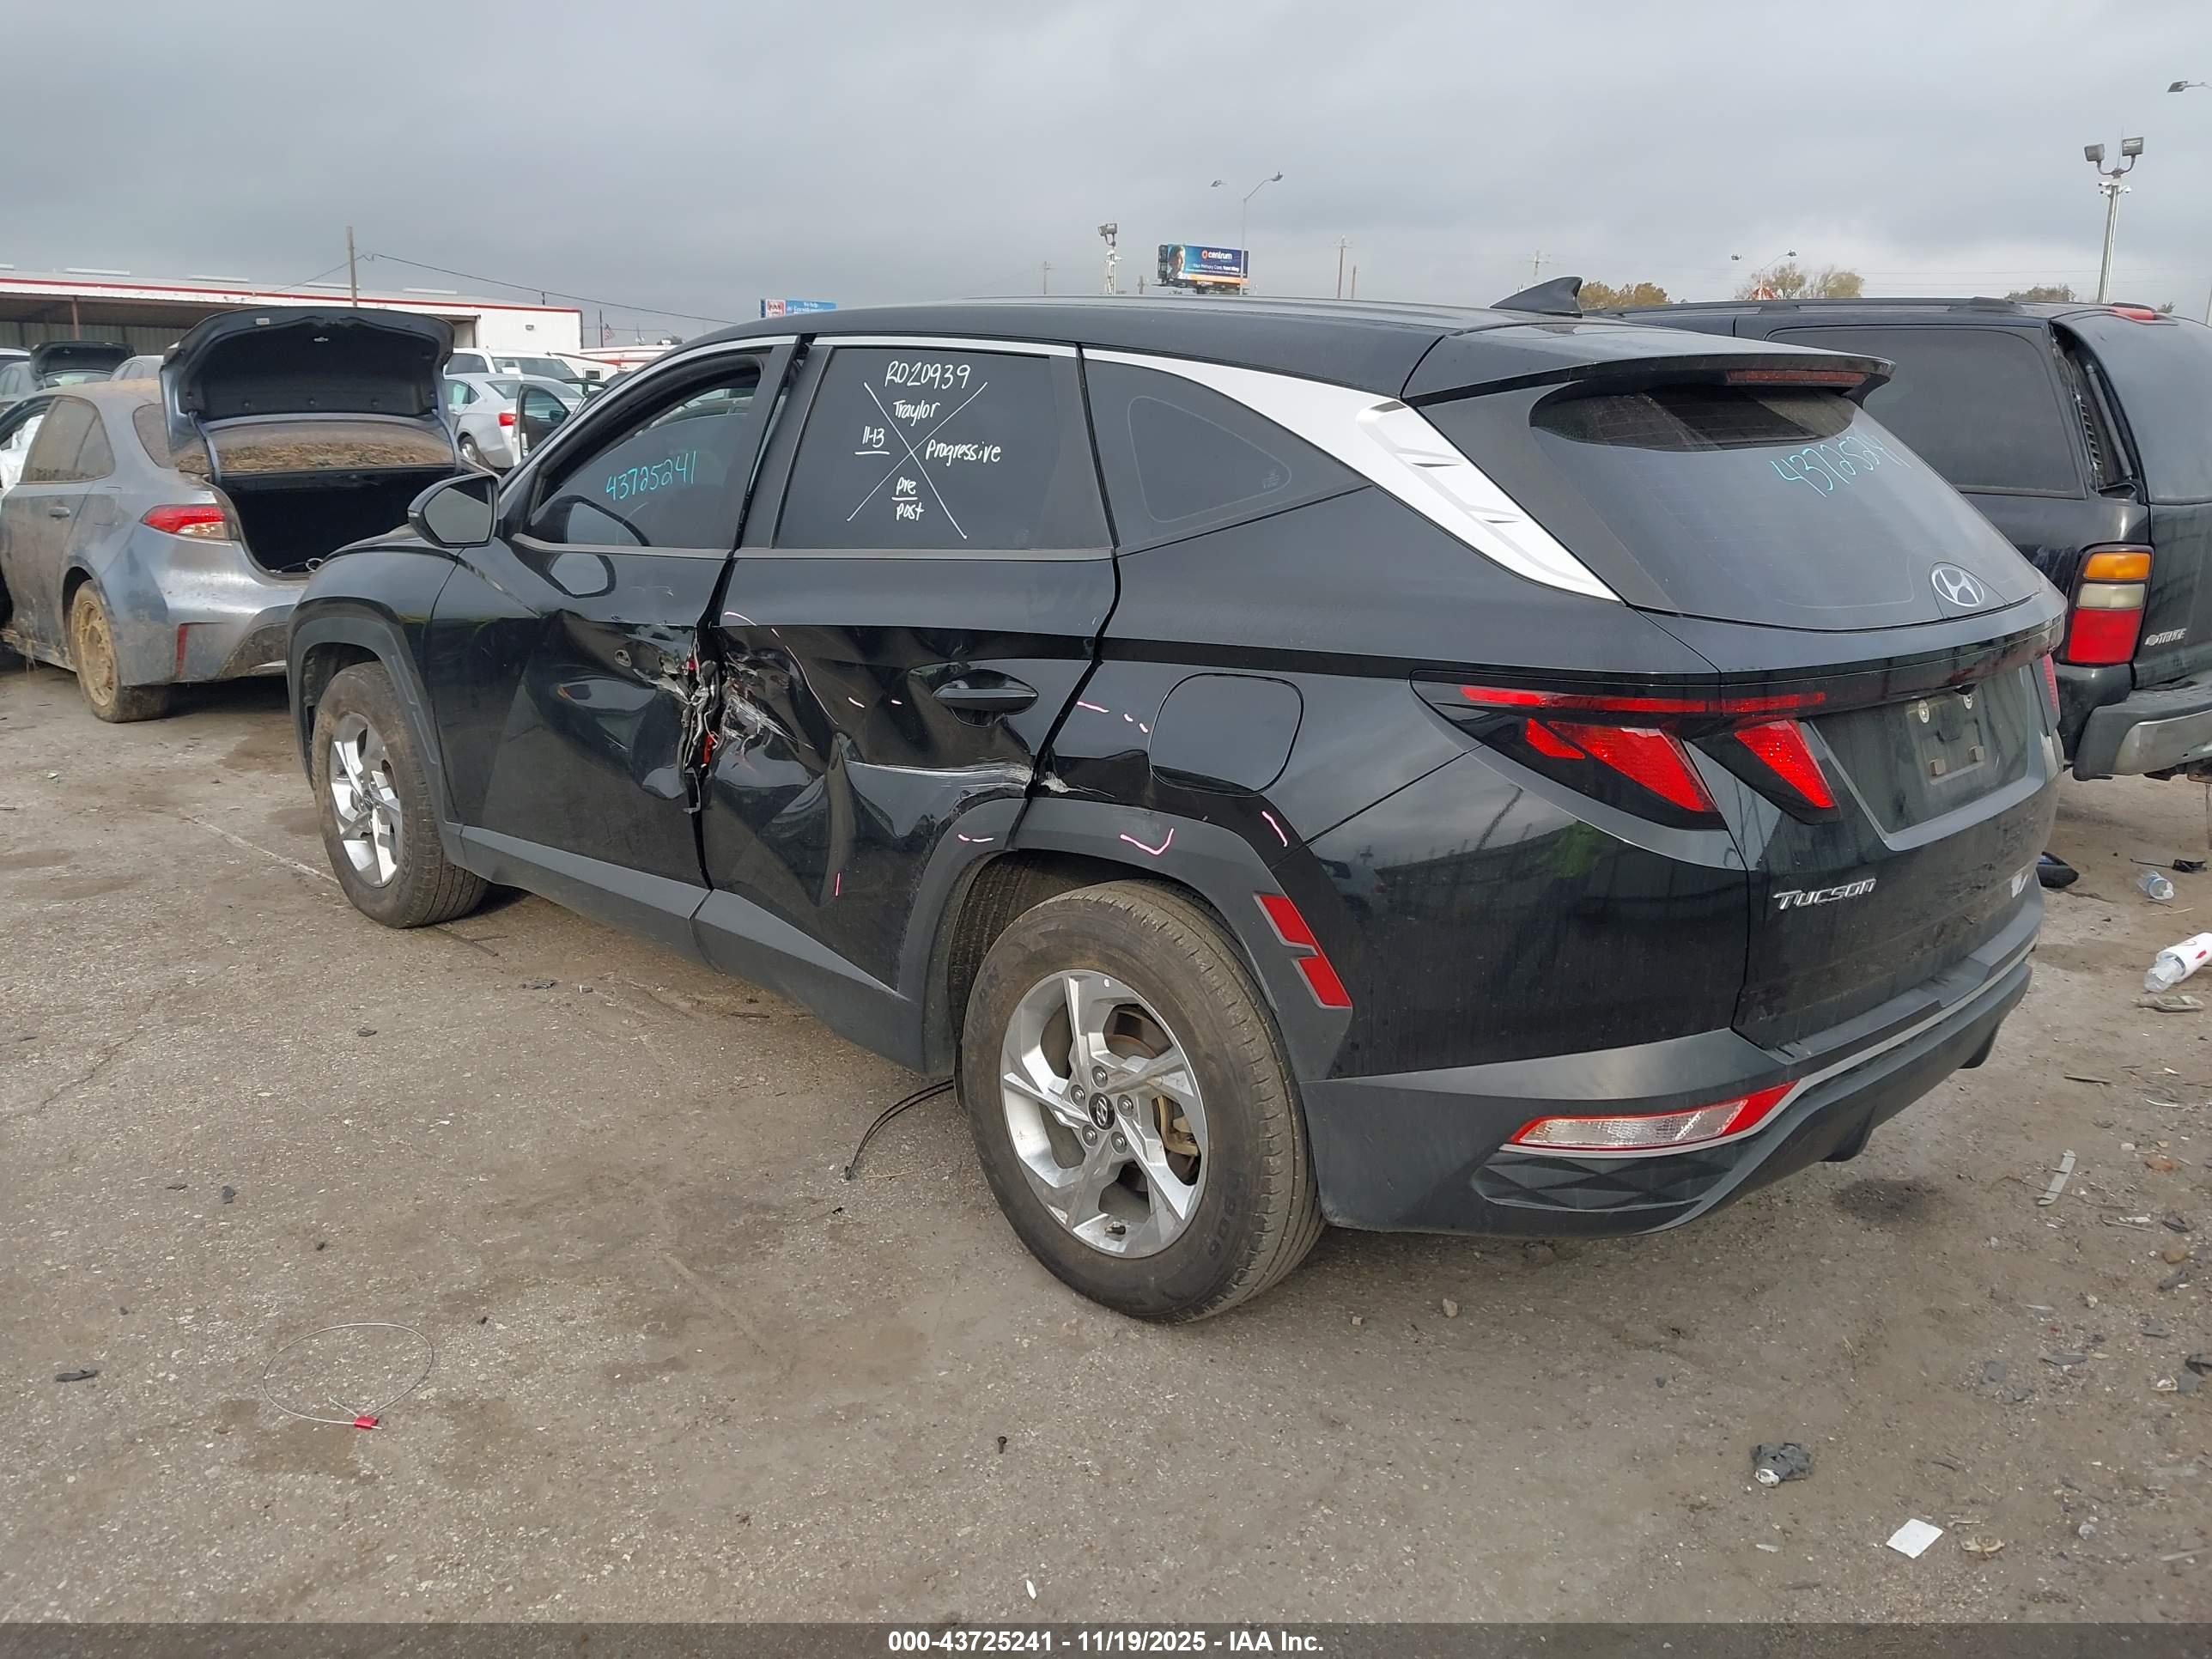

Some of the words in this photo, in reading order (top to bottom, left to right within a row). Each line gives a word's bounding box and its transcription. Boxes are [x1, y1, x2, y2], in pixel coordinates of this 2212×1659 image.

[892, 399, 940, 427] Traylor
[861, 425, 885, 448] 11-13
[925, 439, 1002, 467] Progressive
[605, 450, 696, 501] 43725241
[1772, 878, 1877, 910] TUCSON
